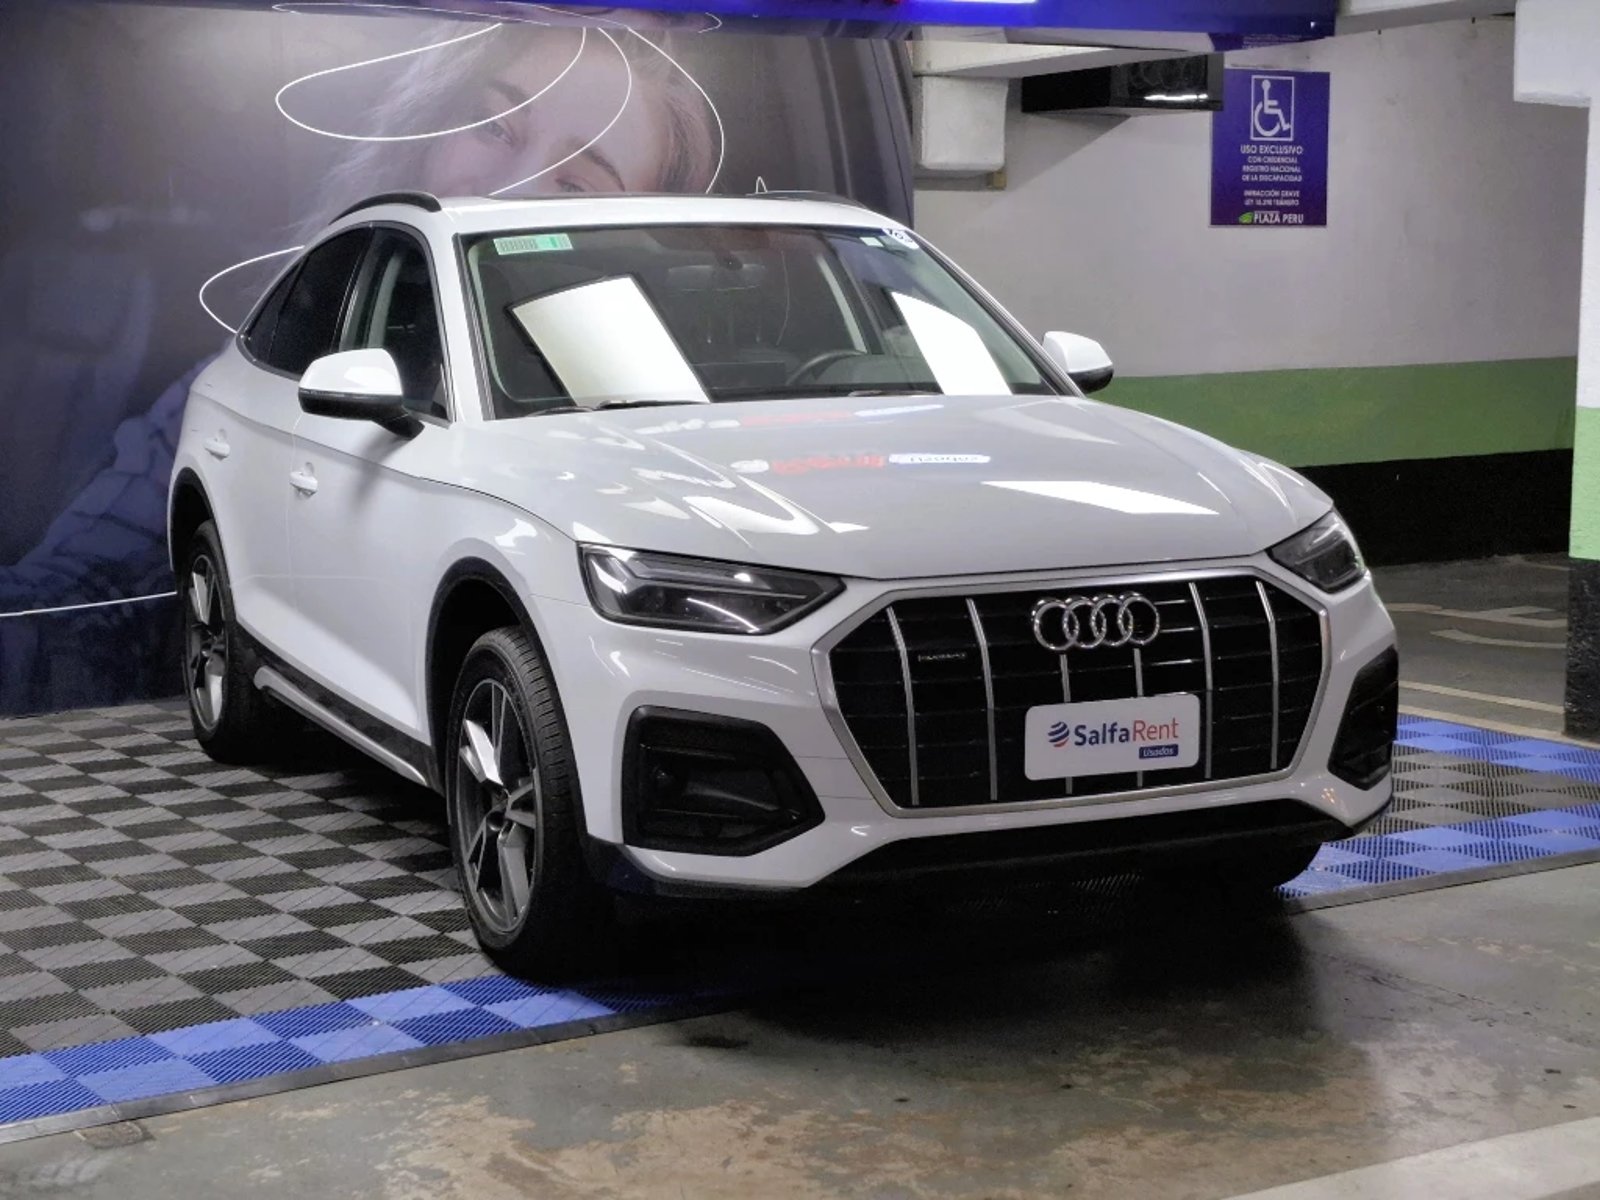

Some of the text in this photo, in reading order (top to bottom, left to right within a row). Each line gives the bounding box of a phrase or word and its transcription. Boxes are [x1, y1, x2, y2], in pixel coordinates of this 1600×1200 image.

[1240, 145, 1303, 155] USO EXCLUSIVO
[1254, 213, 1280, 223] PLAZA
[1073, 717, 1179, 746] SalfaRent
[1143, 749, 1174, 757] Usados
